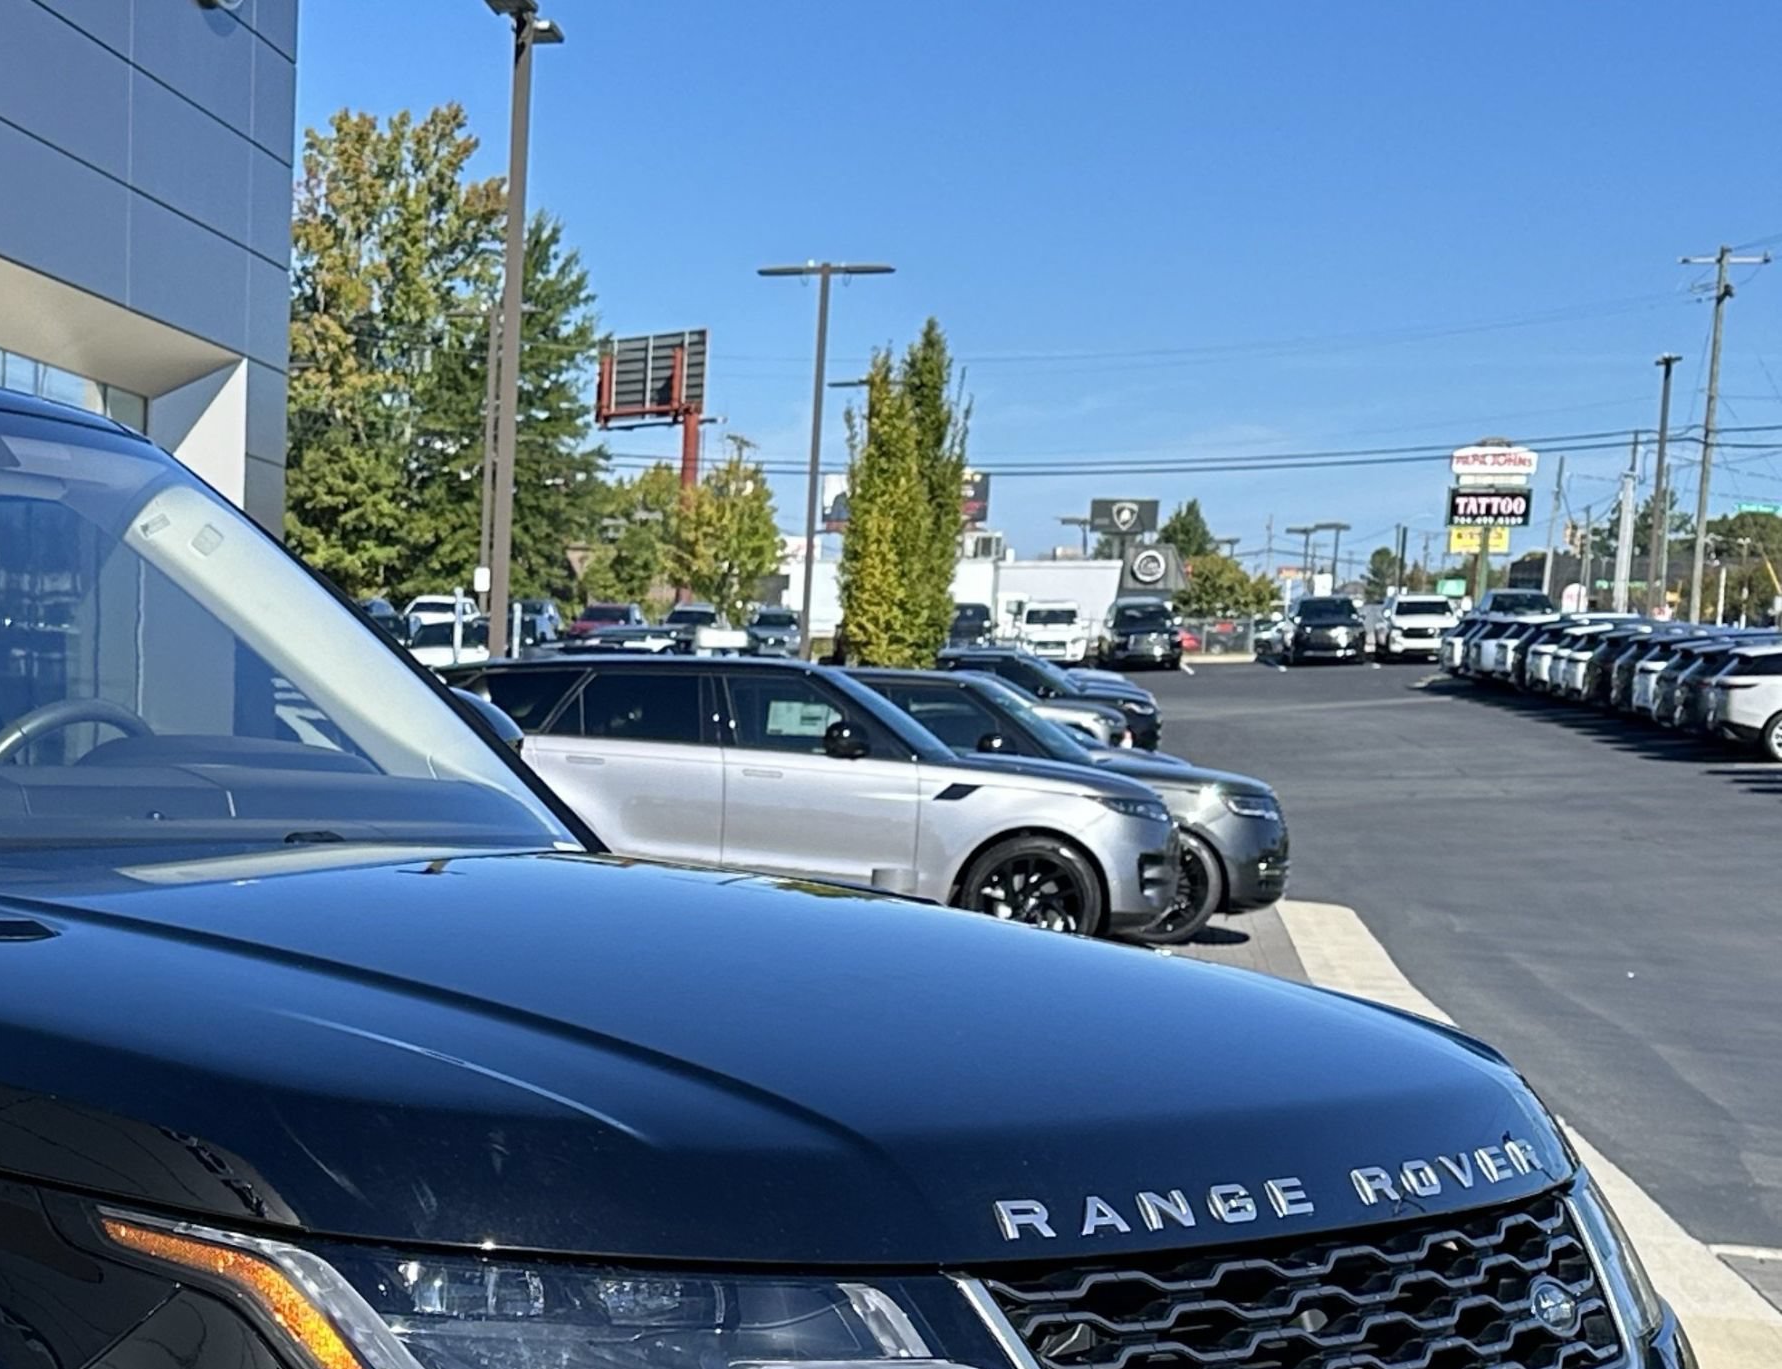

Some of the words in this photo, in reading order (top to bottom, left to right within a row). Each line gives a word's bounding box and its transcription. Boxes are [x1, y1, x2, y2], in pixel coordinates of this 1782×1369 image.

[1455, 496, 1527, 515] TATTOO
[993, 1176, 1315, 1242] RANGE
[1350, 1138, 1544, 1207] ROVER
